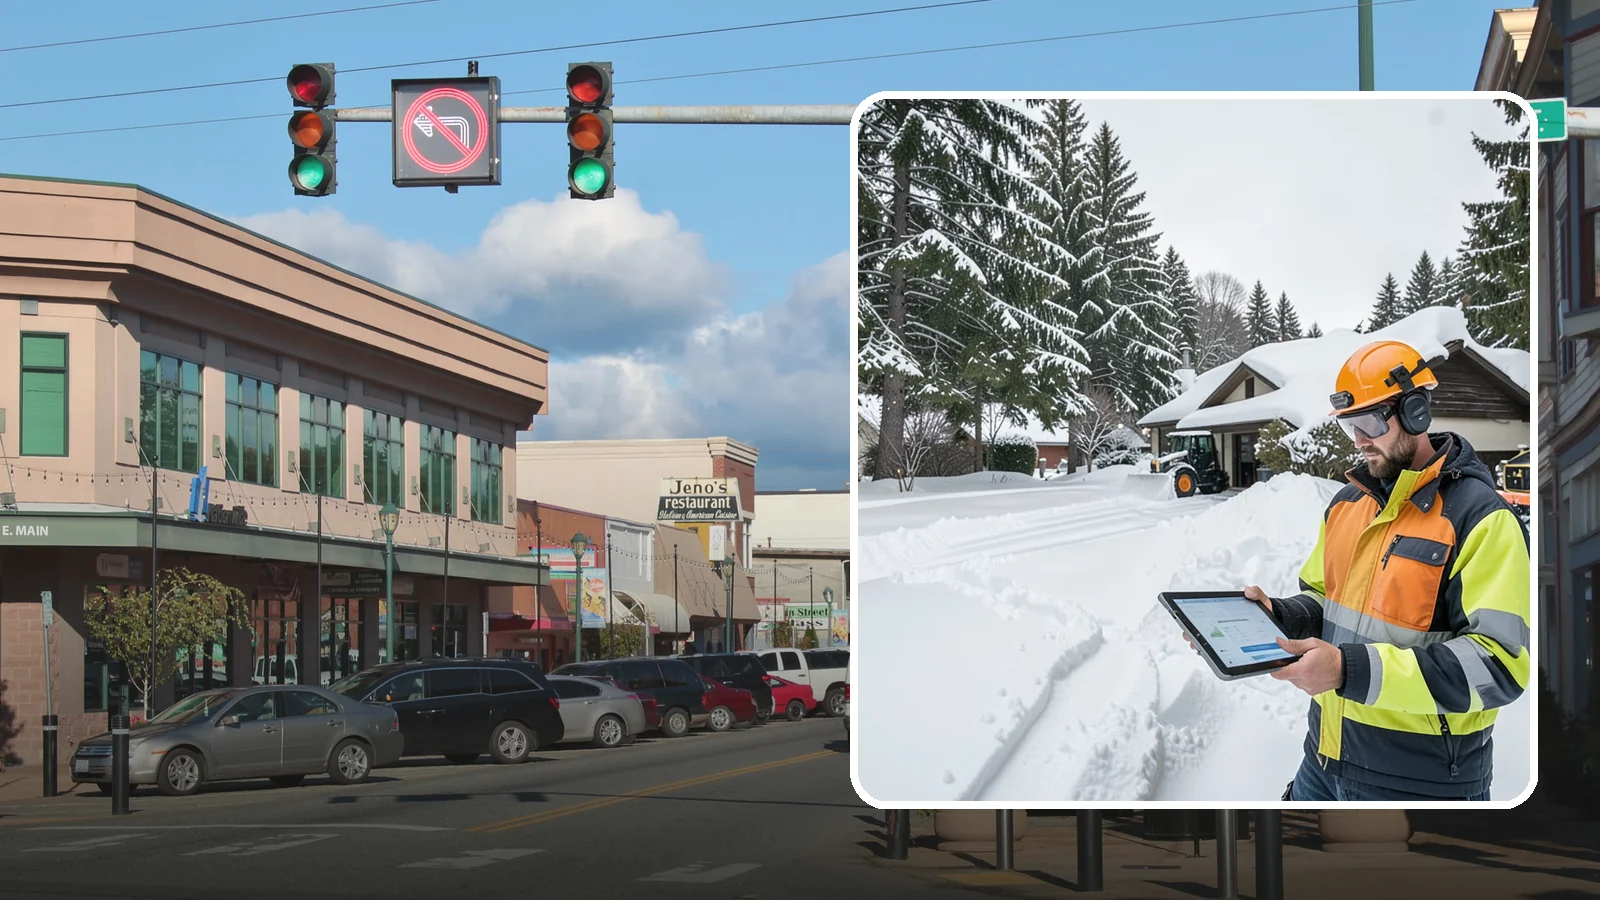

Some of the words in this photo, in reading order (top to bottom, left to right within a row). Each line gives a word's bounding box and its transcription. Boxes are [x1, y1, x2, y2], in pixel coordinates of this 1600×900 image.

[670, 480, 727, 494] Jeno's
[665, 496, 731, 509] restaurant
[659, 509, 681, 519] Italian
[686, 509, 714, 519] American
[715, 509, 737, 519] Cuisine
[2, 525, 13, 536] E.
[15, 525, 49, 536] MAIN
[797, 607, 829, 617] Street
